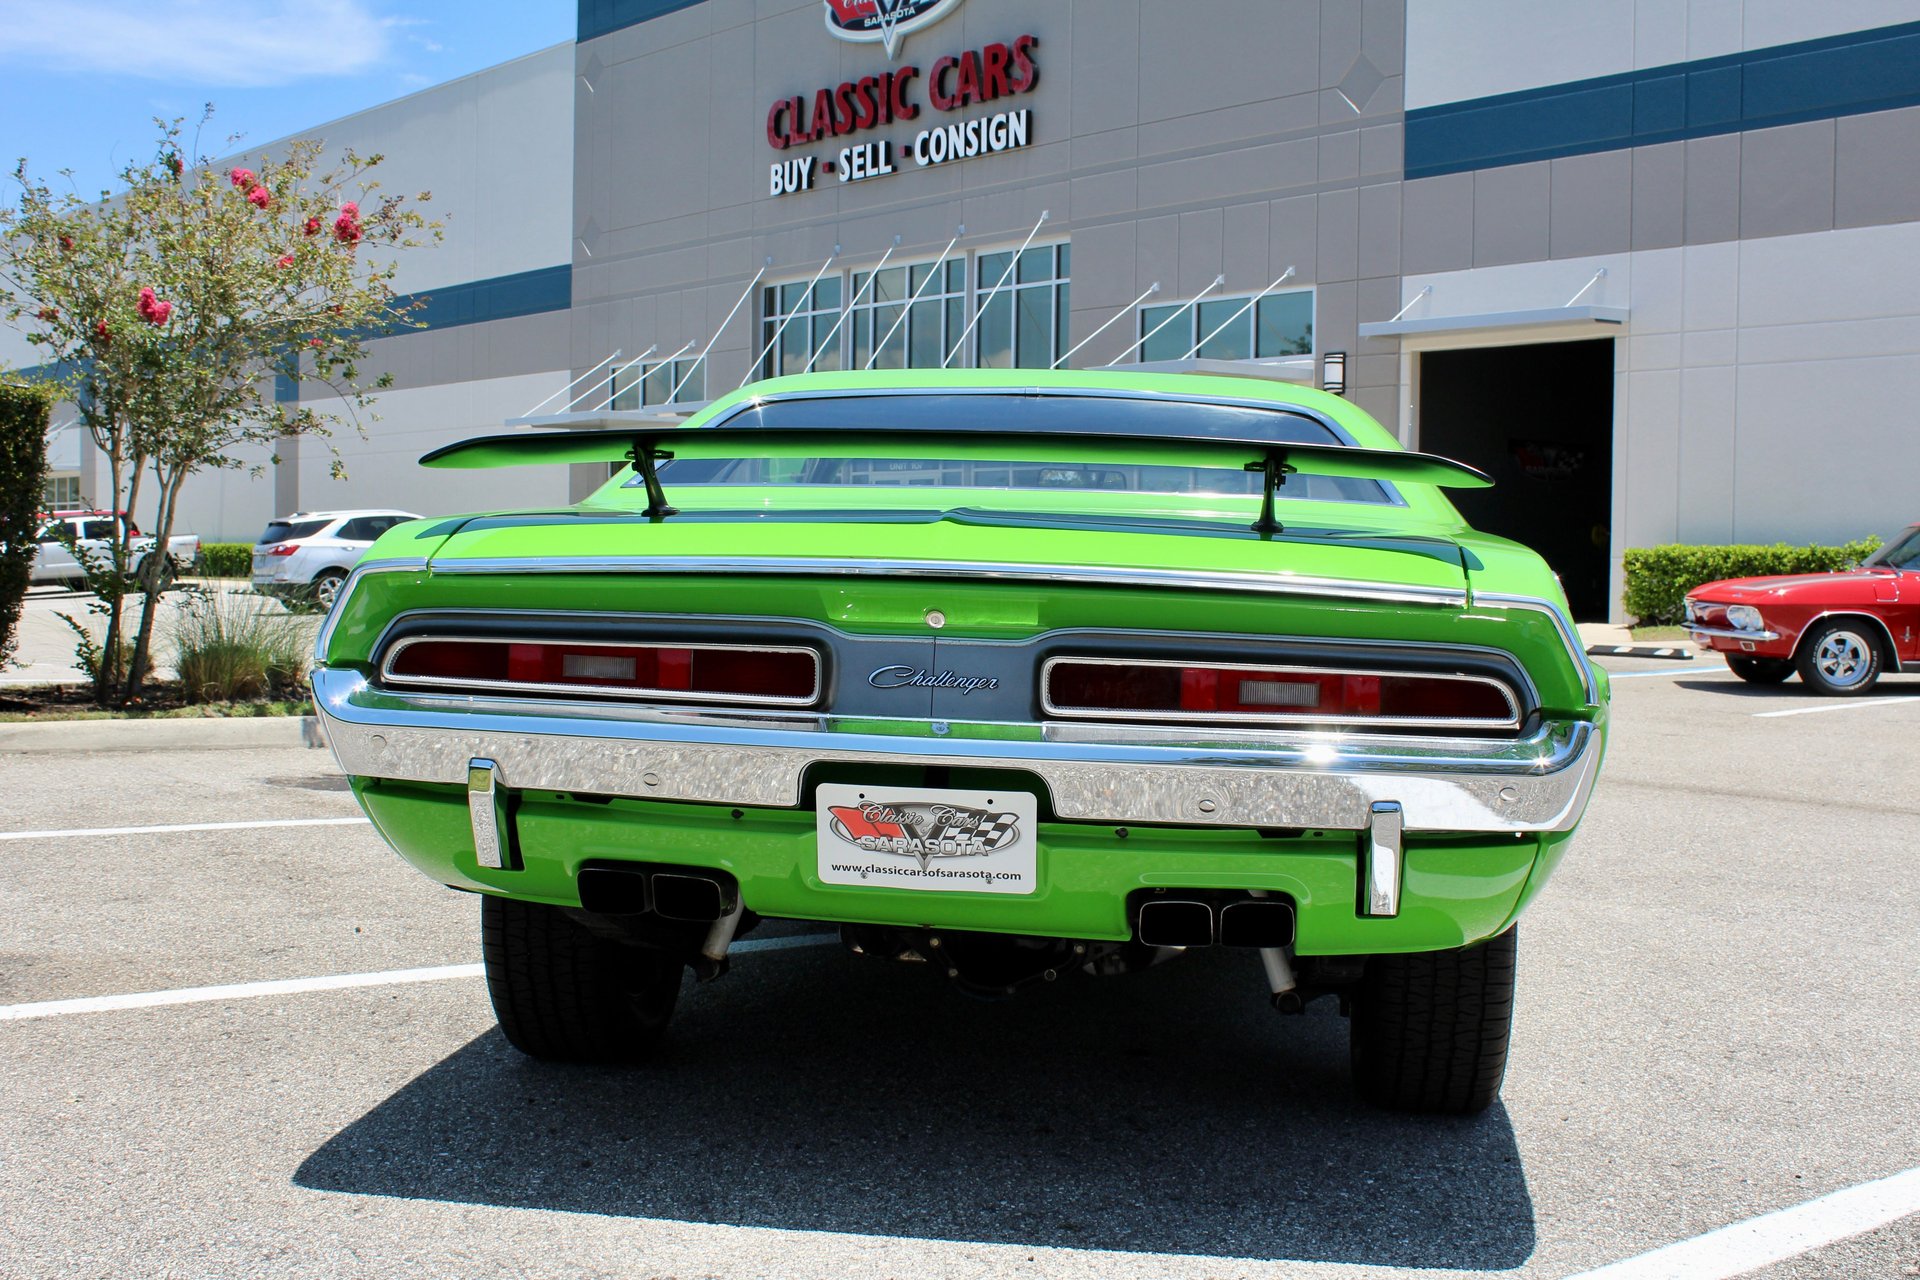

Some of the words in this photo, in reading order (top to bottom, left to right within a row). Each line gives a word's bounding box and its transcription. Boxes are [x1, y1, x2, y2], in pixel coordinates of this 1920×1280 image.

[864, 6, 916, 27] SARASOTA
[767, 66, 918, 150] CLASSIC
[929, 35, 1038, 112] CARS
[770, 156, 816, 196] BUY
[839, 140, 895, 182] SELL
[914, 109, 1031, 166] CONSIGN
[868, 664, 999, 695] Challenger
[858, 800, 924, 826] Classic
[930, 804, 981, 829] Cars
[860, 834, 989, 857] SARASOTA
[831, 863, 1022, 881] www.classiccarsofsarasota.com
